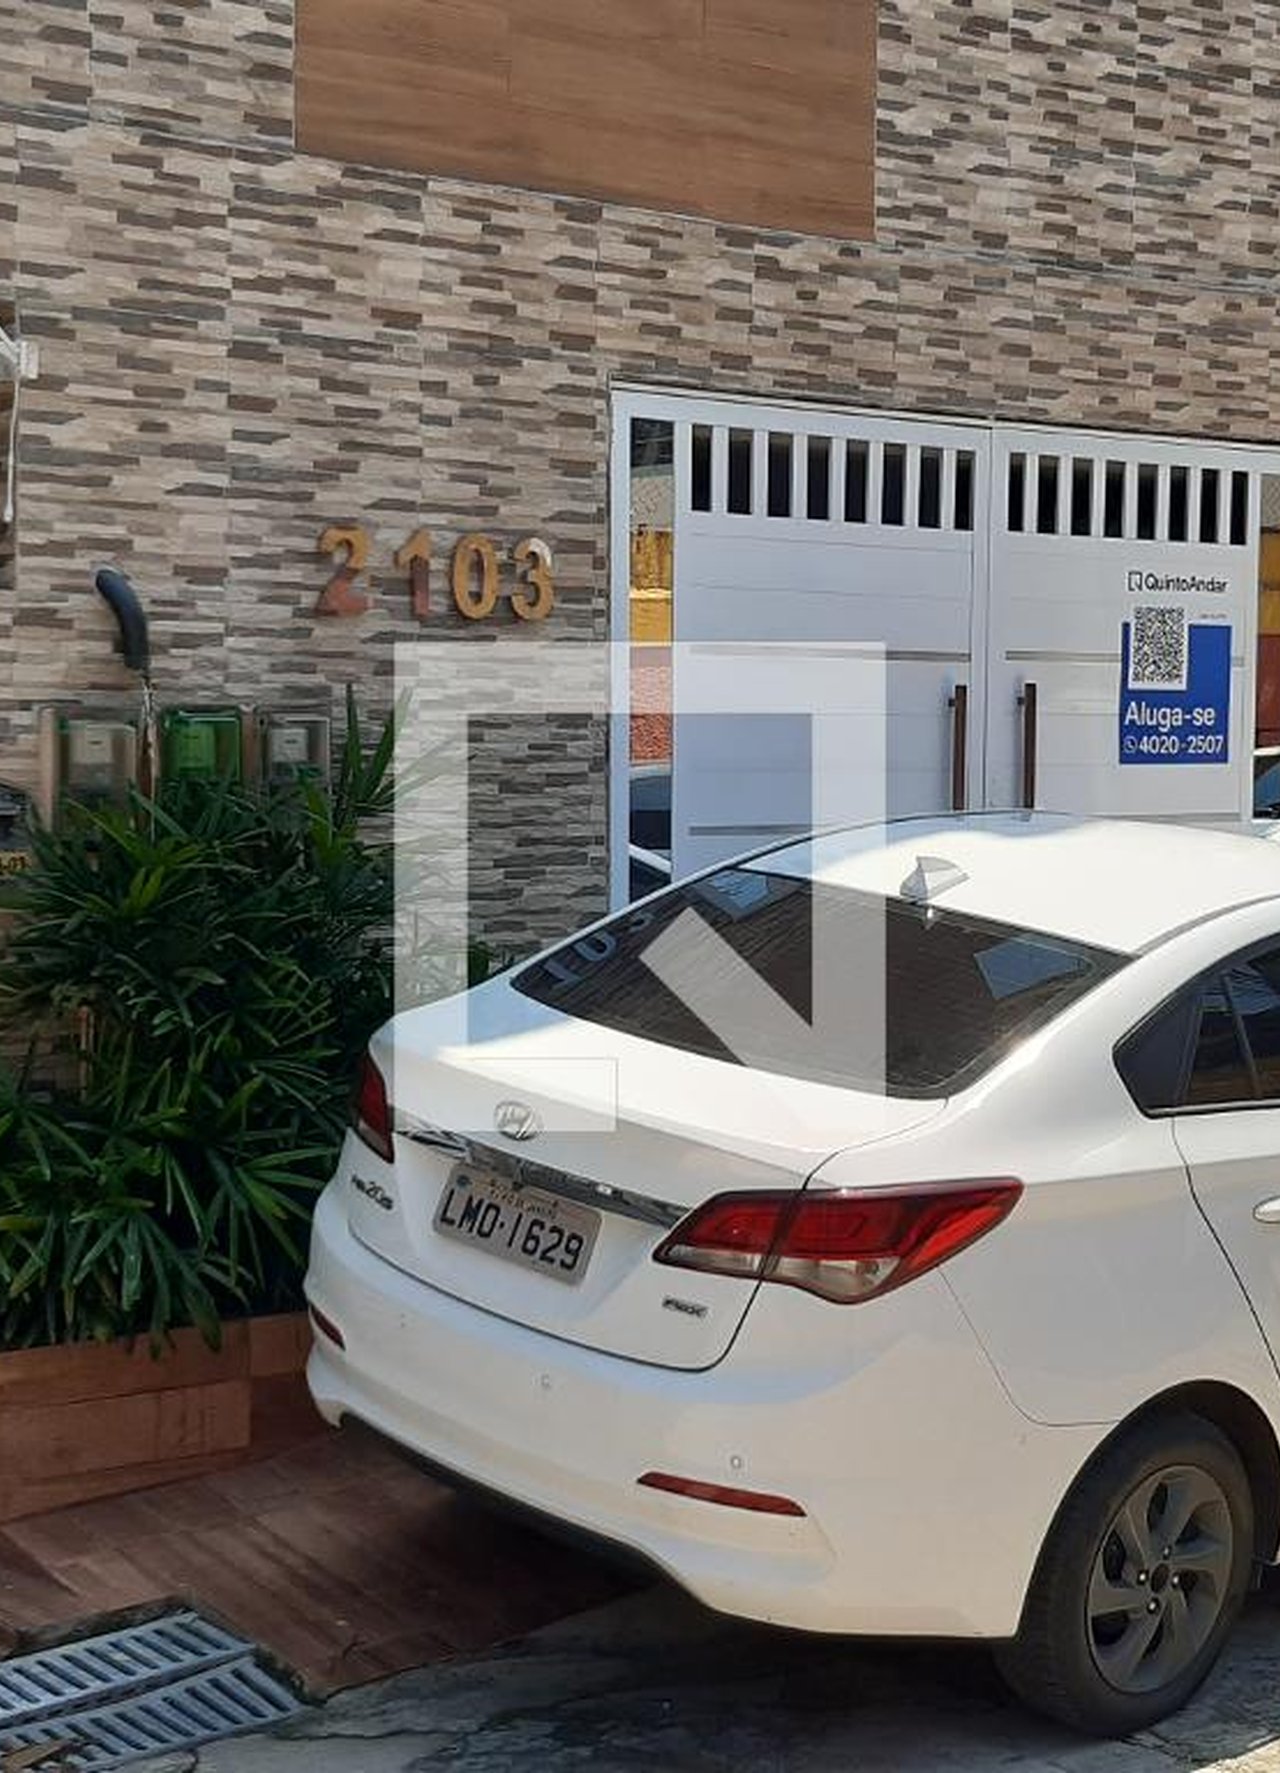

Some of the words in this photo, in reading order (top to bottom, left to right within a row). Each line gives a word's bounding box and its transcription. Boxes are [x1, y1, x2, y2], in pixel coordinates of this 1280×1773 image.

[317, 525, 554, 621] 2103
[1144, 573, 1228, 593] QuintoAndar
[1124, 701, 1216, 732] Aluga-se
[1139, 735, 1224, 755] 4020-2507
